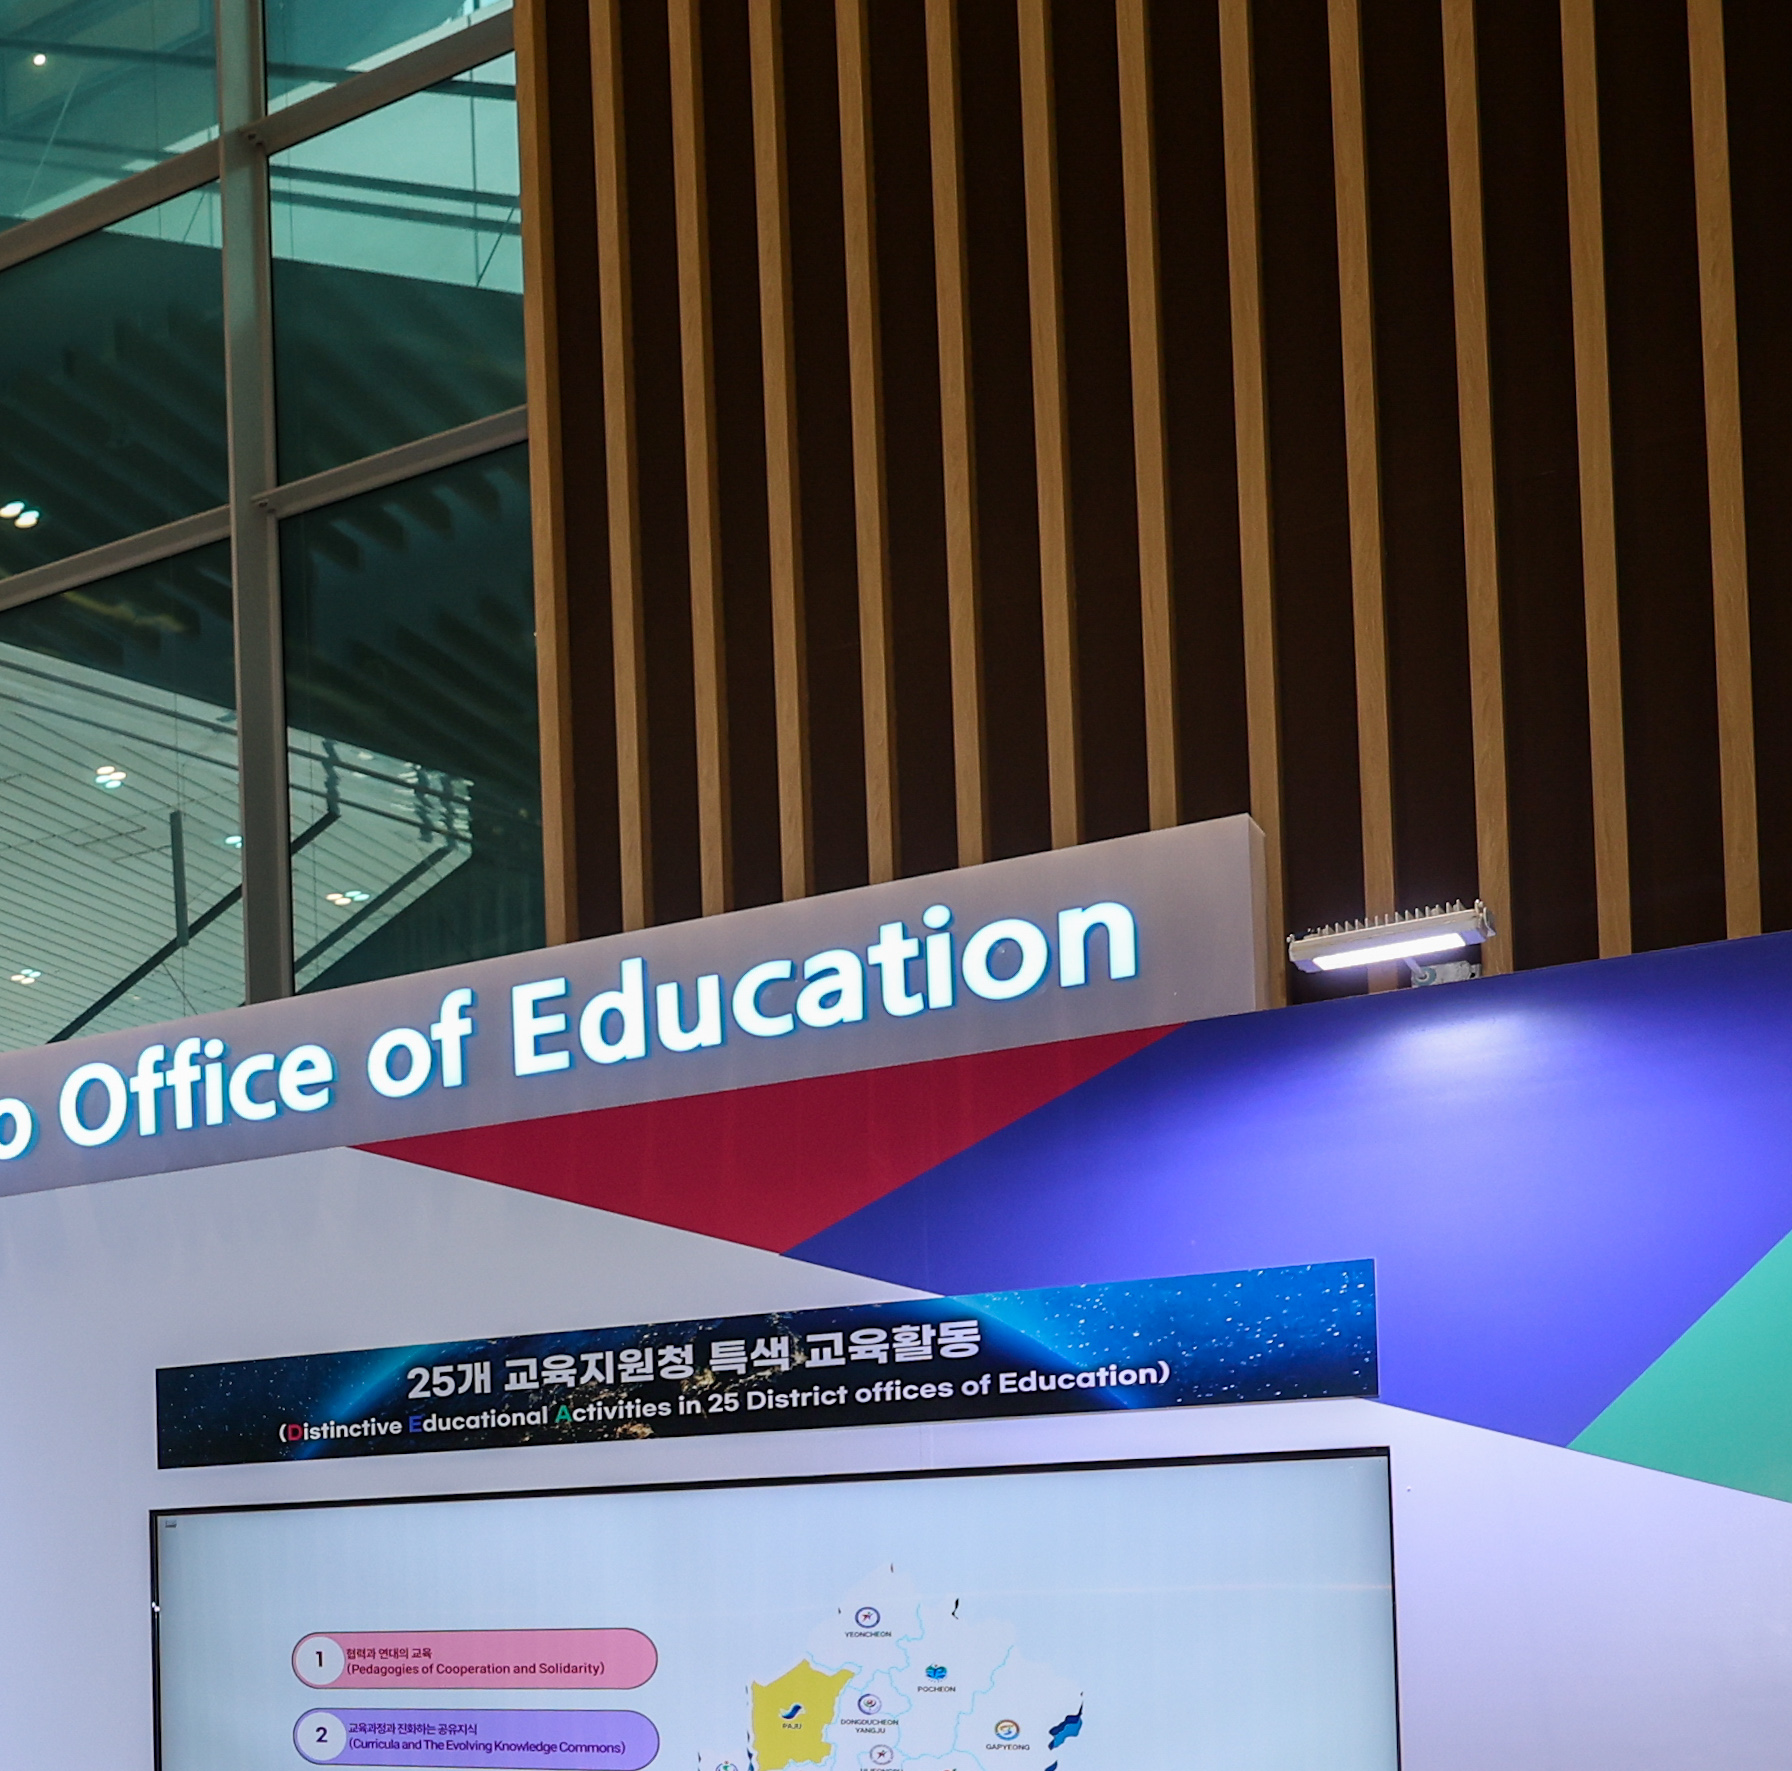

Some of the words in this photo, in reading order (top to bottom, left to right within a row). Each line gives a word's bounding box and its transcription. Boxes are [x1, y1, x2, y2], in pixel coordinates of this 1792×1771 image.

[57, 1035, 331, 1148] Office
[366, 987, 472, 1099] of
[511, 901, 1139, 1077] Education
[407, 1363, 491, 1399] 25개
[504, 1342, 695, 1394] 교육지원청
[708, 1336, 790, 1377] 특색
[805, 1319, 982, 1371] 교육활동
[280, 1418, 402, 1442] (Distinctive
[409, 1406, 548, 1433] Educational
[555, 1397, 672, 1425] Activities
[679, 1392, 702, 1415] in
[708, 1391, 741, 1414] 25
[747, 1385, 849, 1411] District
[855, 1380, 954, 1404] offices
[961, 1373, 993, 1397] of
[999, 1361, 1170, 1394] Education)
[315, 1651, 323, 1668] 1
[347, 1663, 419, 1677] (Pedagogies
[421, 1663, 434, 1675] of
[436, 1663, 511, 1676] Cooperation
[513, 1663, 536, 1674] and
[539, 1662, 605, 1676] Solidarity)
[315, 1726, 328, 1743] 2
[349, 1738, 401, 1750] (Curricula
[401, 1739, 422, 1750] and
[423, 1739, 445, 1751] The
[446, 1739, 493, 1754] Evolving
[494, 1740, 558, 1755] Knowledge
[558, 1741, 626, 1755] Commons)
